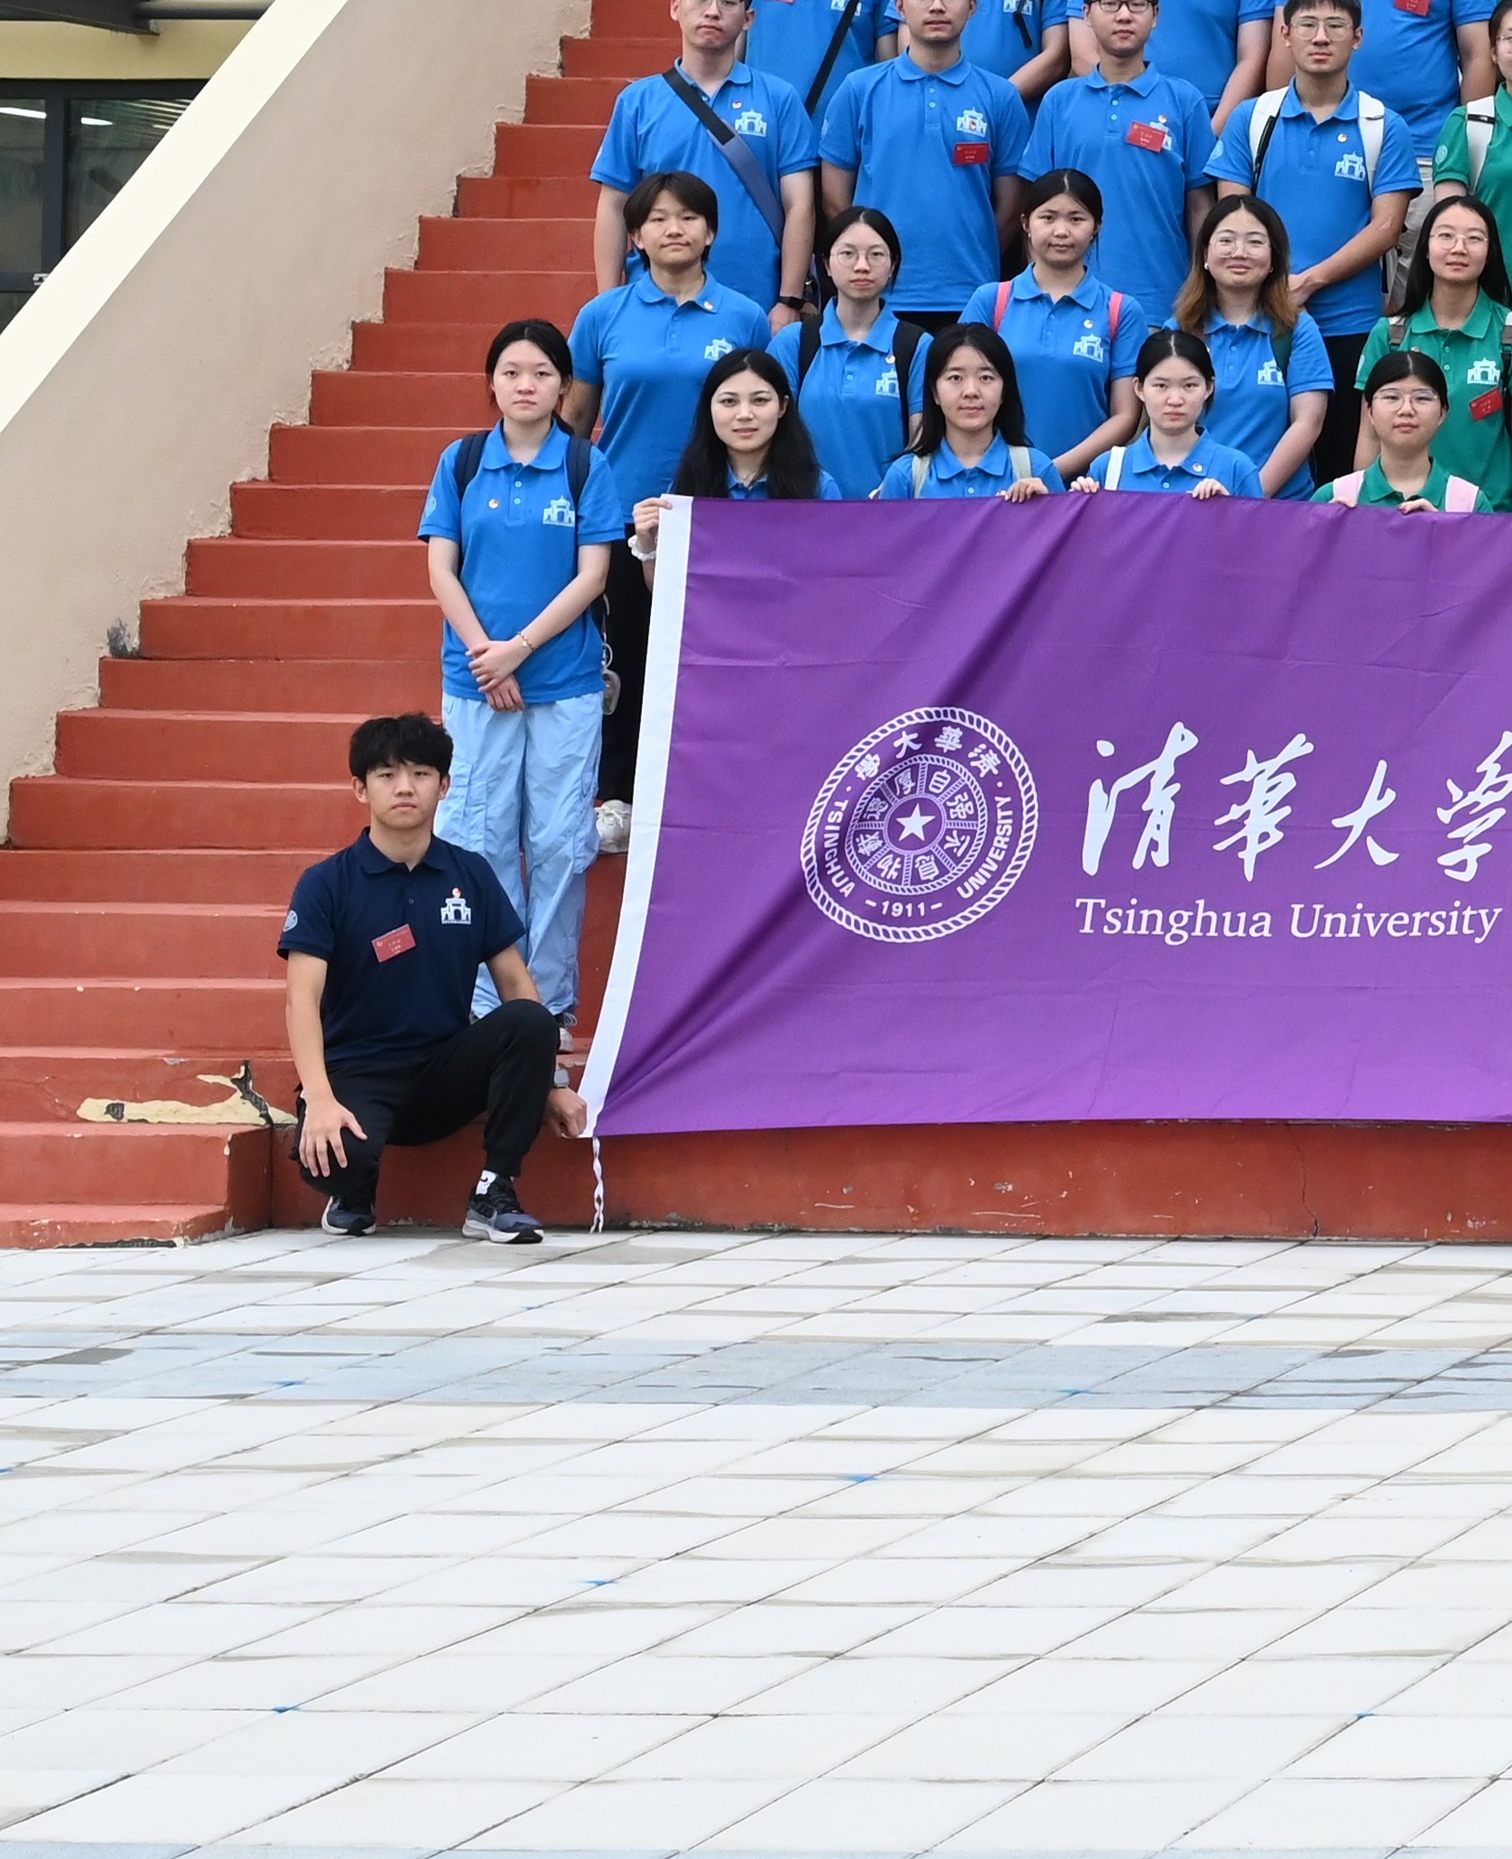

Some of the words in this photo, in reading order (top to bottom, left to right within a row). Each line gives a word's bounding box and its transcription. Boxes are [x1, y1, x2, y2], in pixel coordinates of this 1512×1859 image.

[823, 799, 856, 898] TSINGHUA
[955, 795, 1014, 899] UNIVERSITY
[1074, 897, 1273, 946] Tsinghua
[1289, 899, 1504, 944] University
